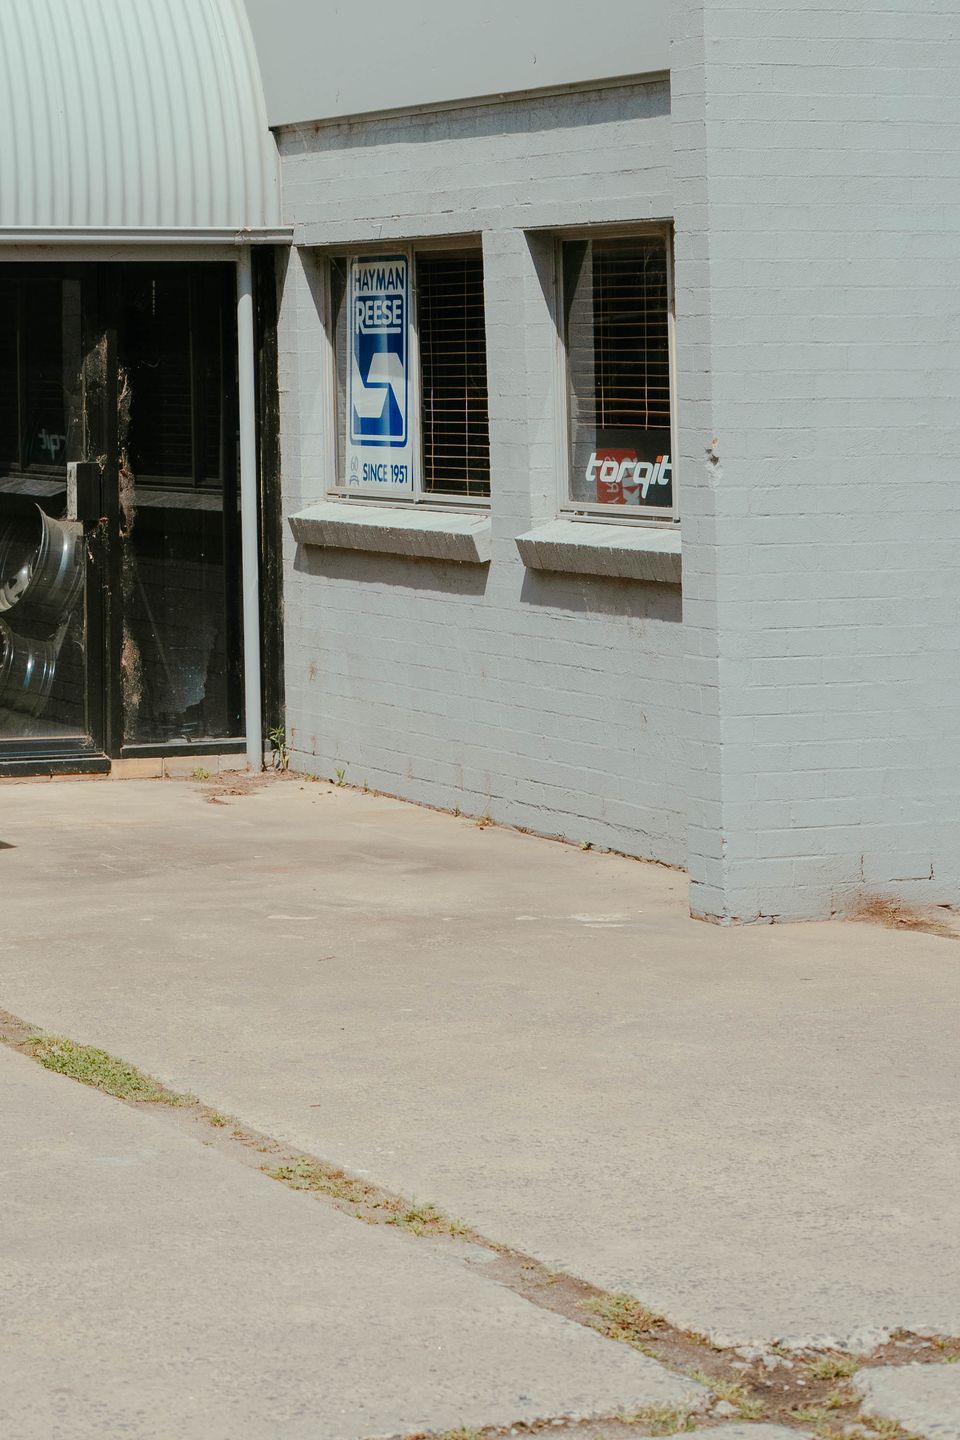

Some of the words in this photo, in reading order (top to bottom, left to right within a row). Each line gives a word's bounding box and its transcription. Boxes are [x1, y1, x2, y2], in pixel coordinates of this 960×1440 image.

[354, 266, 404, 292] HAYMAN
[354, 300, 402, 333] REESE
[363, 463, 388, 482] SINCE
[390, 464, 408, 484] 1951
[585, 452, 673, 499] torqit
